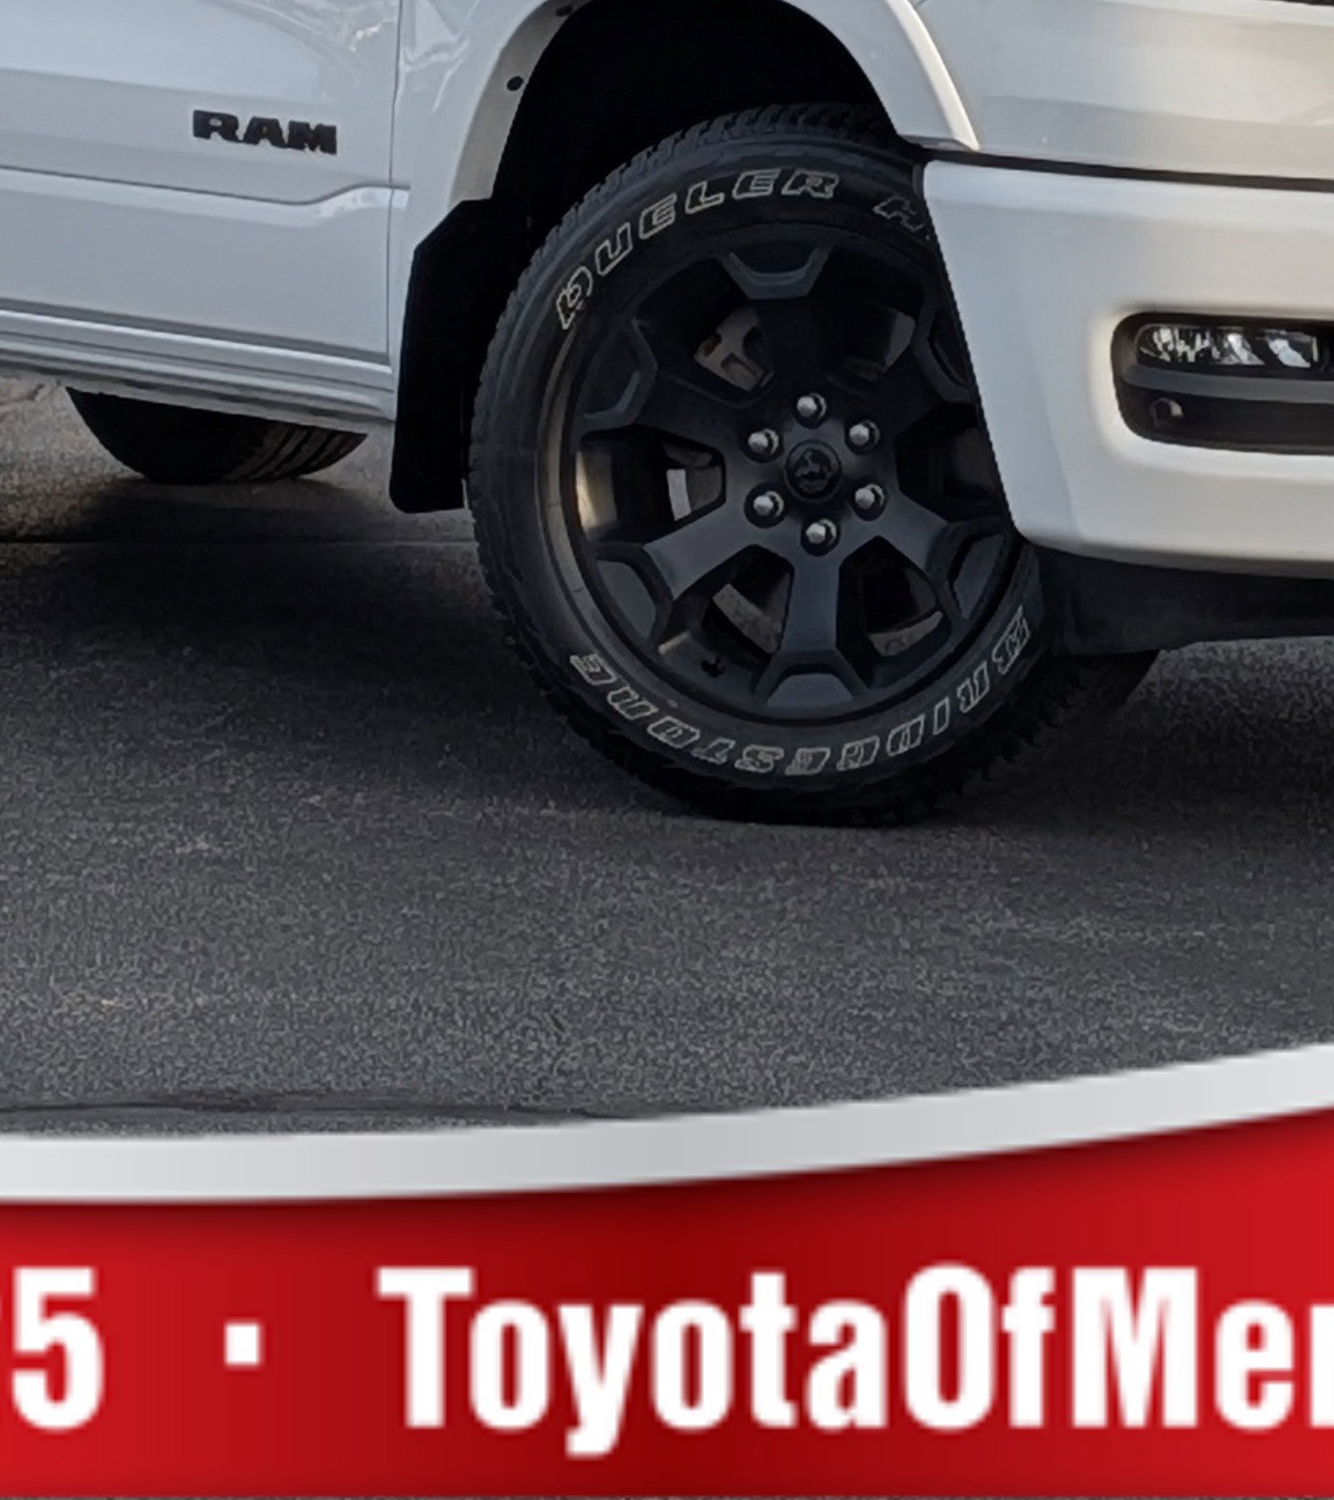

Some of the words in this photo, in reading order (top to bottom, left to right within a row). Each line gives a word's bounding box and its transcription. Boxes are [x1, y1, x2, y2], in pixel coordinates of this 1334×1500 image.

[193, 109, 337, 155] RAM
[554, 168, 839, 329] DUELER
[570, 604, 1032, 776] BRIDGESTONE
